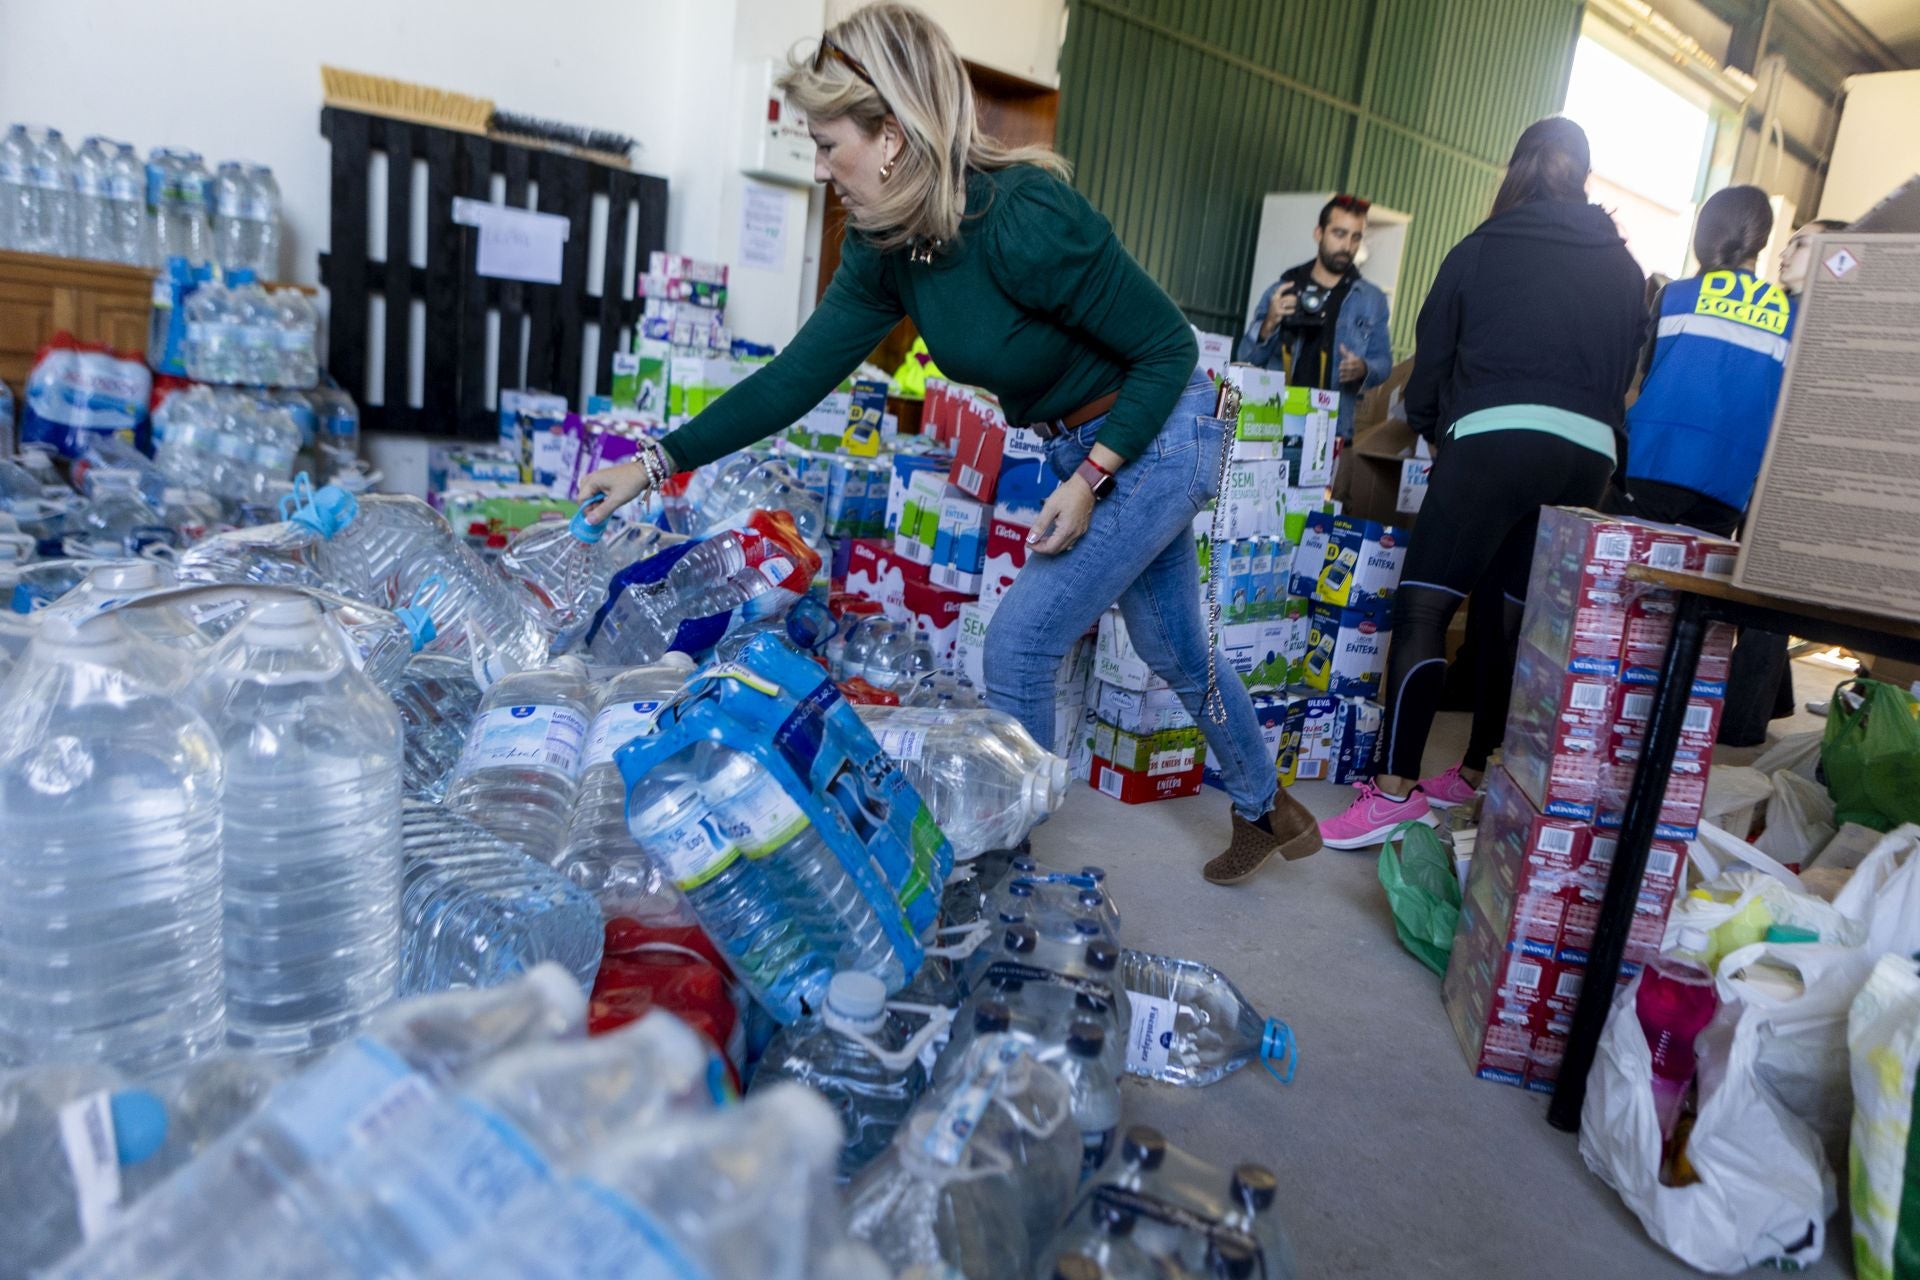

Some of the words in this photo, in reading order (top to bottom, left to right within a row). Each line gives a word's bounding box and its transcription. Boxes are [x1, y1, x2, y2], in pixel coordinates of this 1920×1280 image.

[1699, 270, 1790, 314] DYA
[1701, 298, 1782, 329] SOCIAL
[1232, 472, 1255, 488] SEMI
[945, 509, 969, 520] ENTERA
[1367, 556, 1395, 570] ENTERA
[963, 618, 988, 637] SEM
[1346, 643, 1378, 655] ENTERA
[1322, 722, 1331, 733] 3
